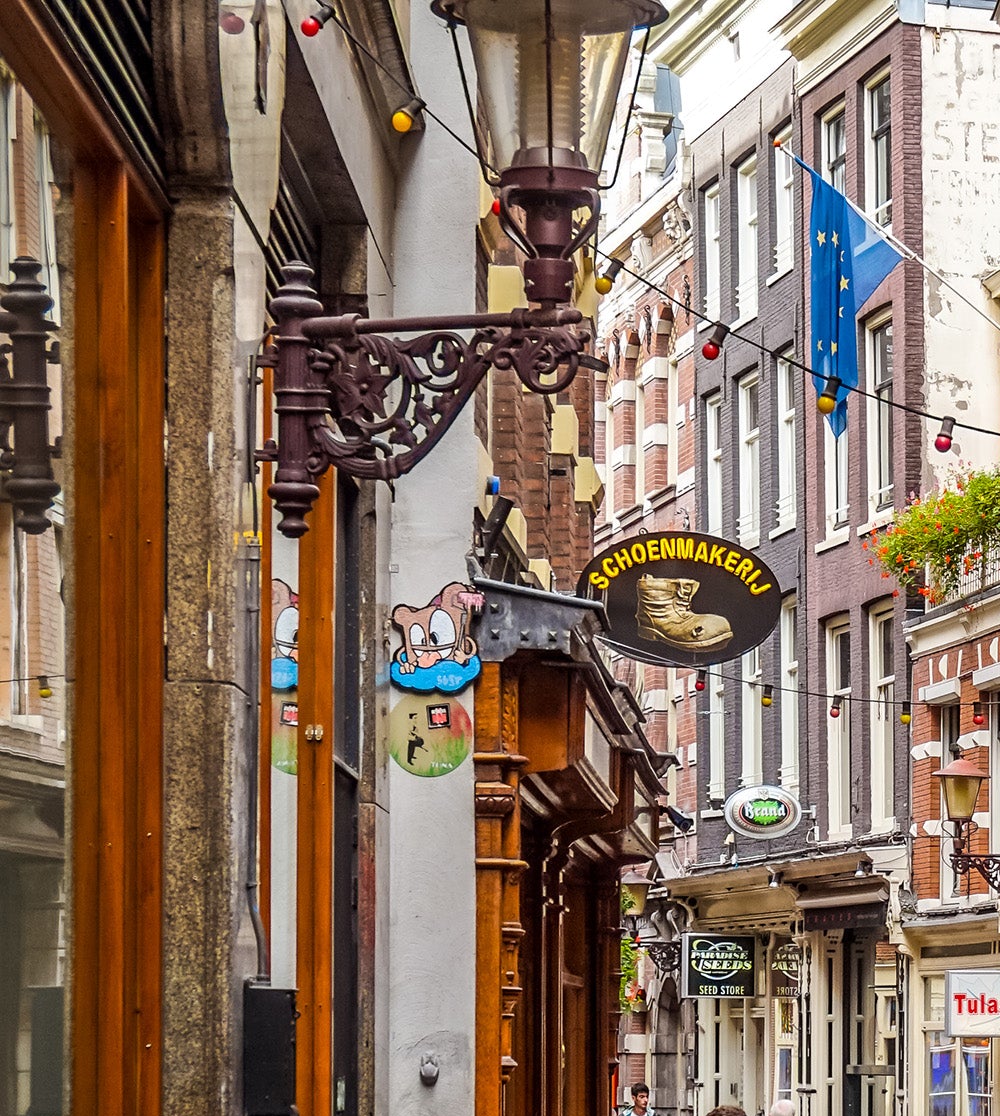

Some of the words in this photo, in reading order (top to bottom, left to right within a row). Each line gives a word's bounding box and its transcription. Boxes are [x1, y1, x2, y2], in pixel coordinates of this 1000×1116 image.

[589, 537, 772, 596] SCHOENMAKERIJ
[743, 800, 786, 819] Brand
[690, 952, 748, 960] PARADISE
[702, 960, 753, 970] SEEDS
[699, 985, 718, 995] SEED
[720, 985, 745, 995] STORE
